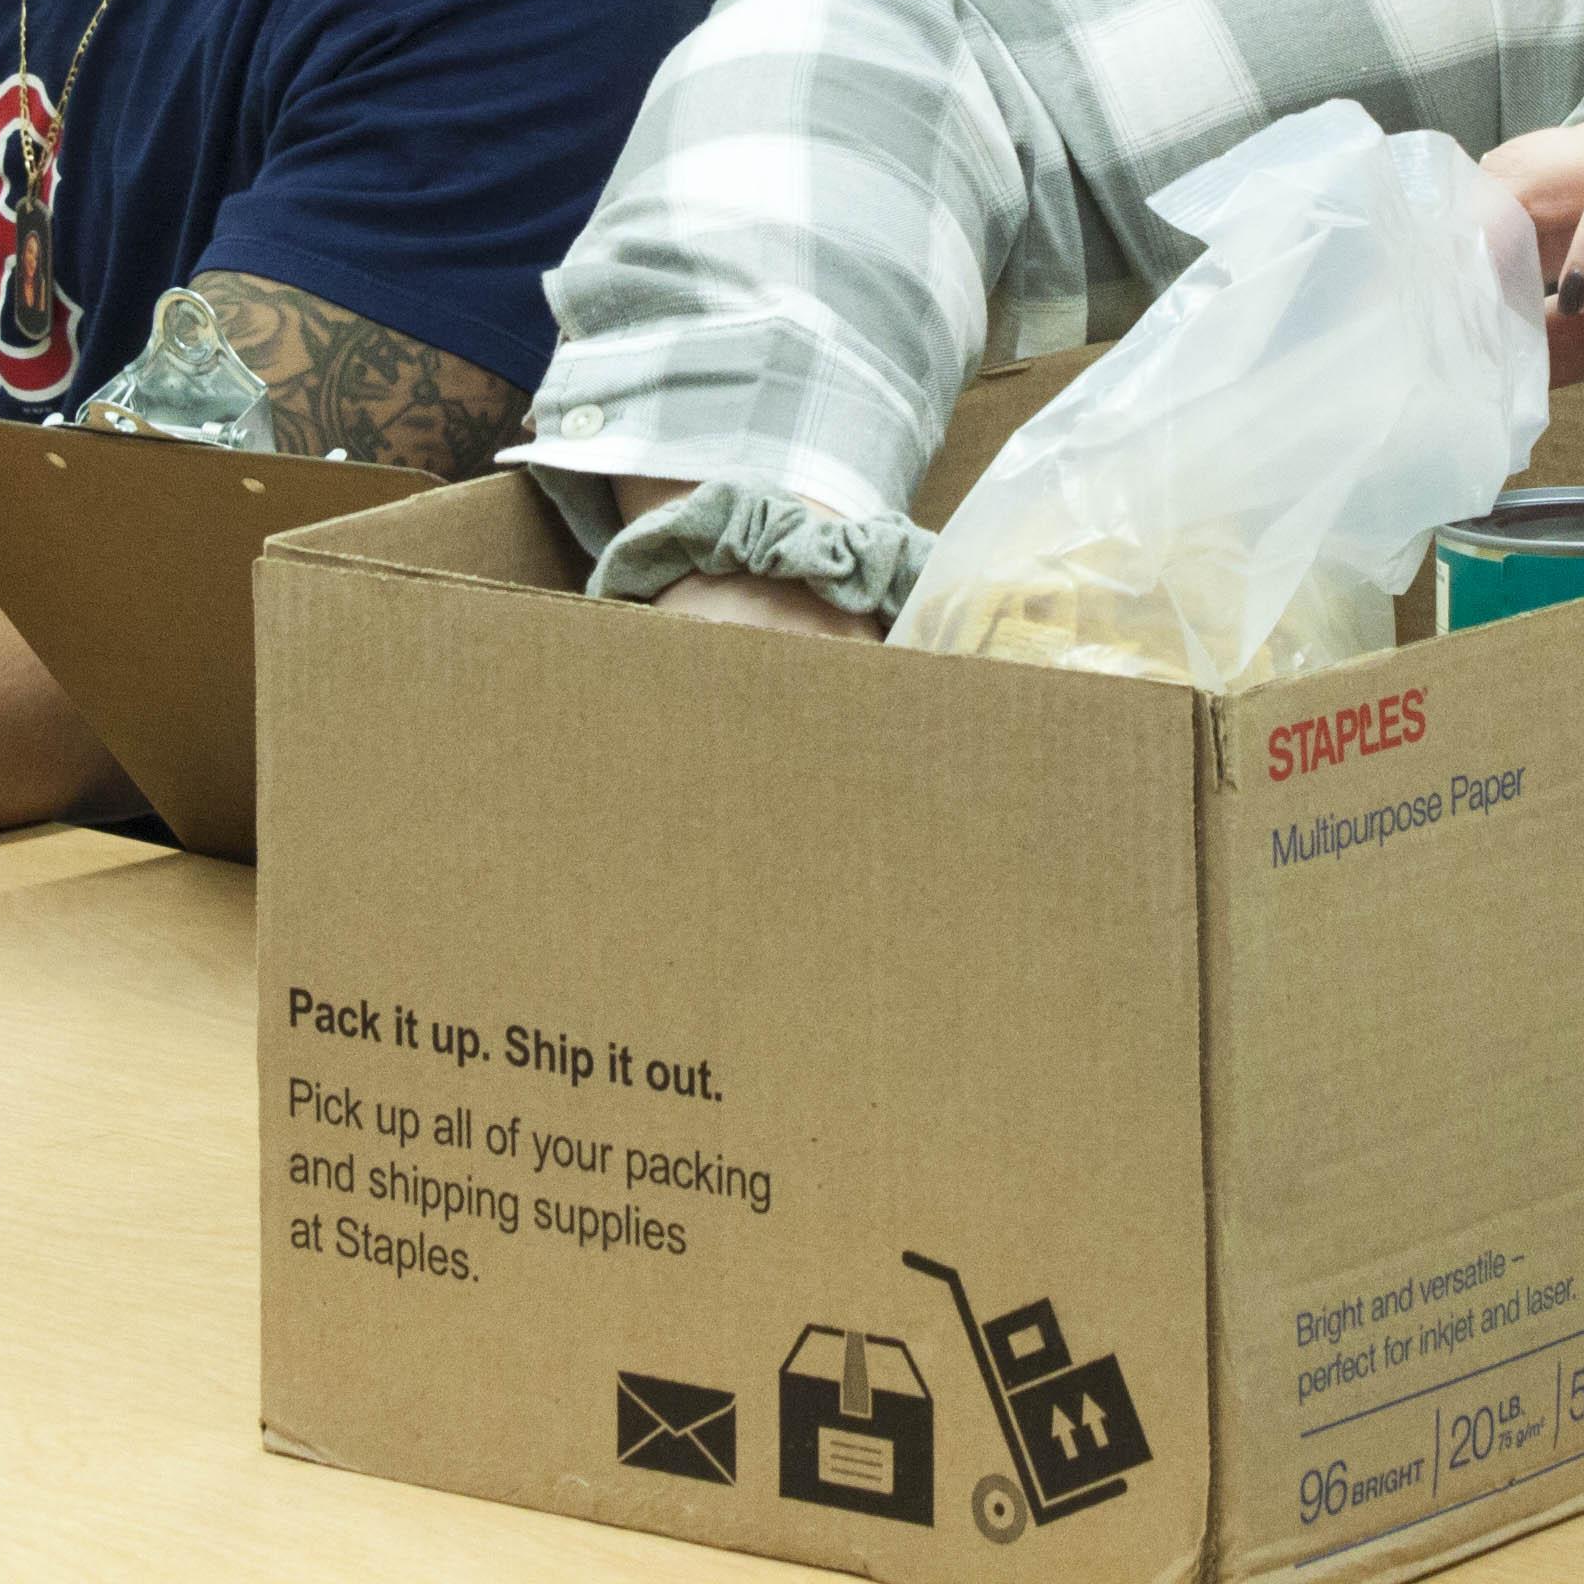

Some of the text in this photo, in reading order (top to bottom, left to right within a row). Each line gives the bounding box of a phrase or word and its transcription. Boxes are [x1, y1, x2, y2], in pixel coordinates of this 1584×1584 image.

[1268, 687, 1426, 782] STAPLES
[1272, 766, 1526, 868] Multipurpose Paper
[289, 987, 724, 1102] Pack it up. Ship it out.
[289, 1076, 772, 1214] Pick up all of your packing
[289, 1153, 687, 1255] and shipping supplies
[290, 1213, 480, 1282] at Staples.
[1296, 1249, 1506, 1347] Bright and versatile
[1297, 1275, 1578, 1405] perfect for inkjet and laser.
[1449, 1393, 1527, 1472] 20 LB.
[1299, 1458, 1425, 1526] 96 BRIGHT
